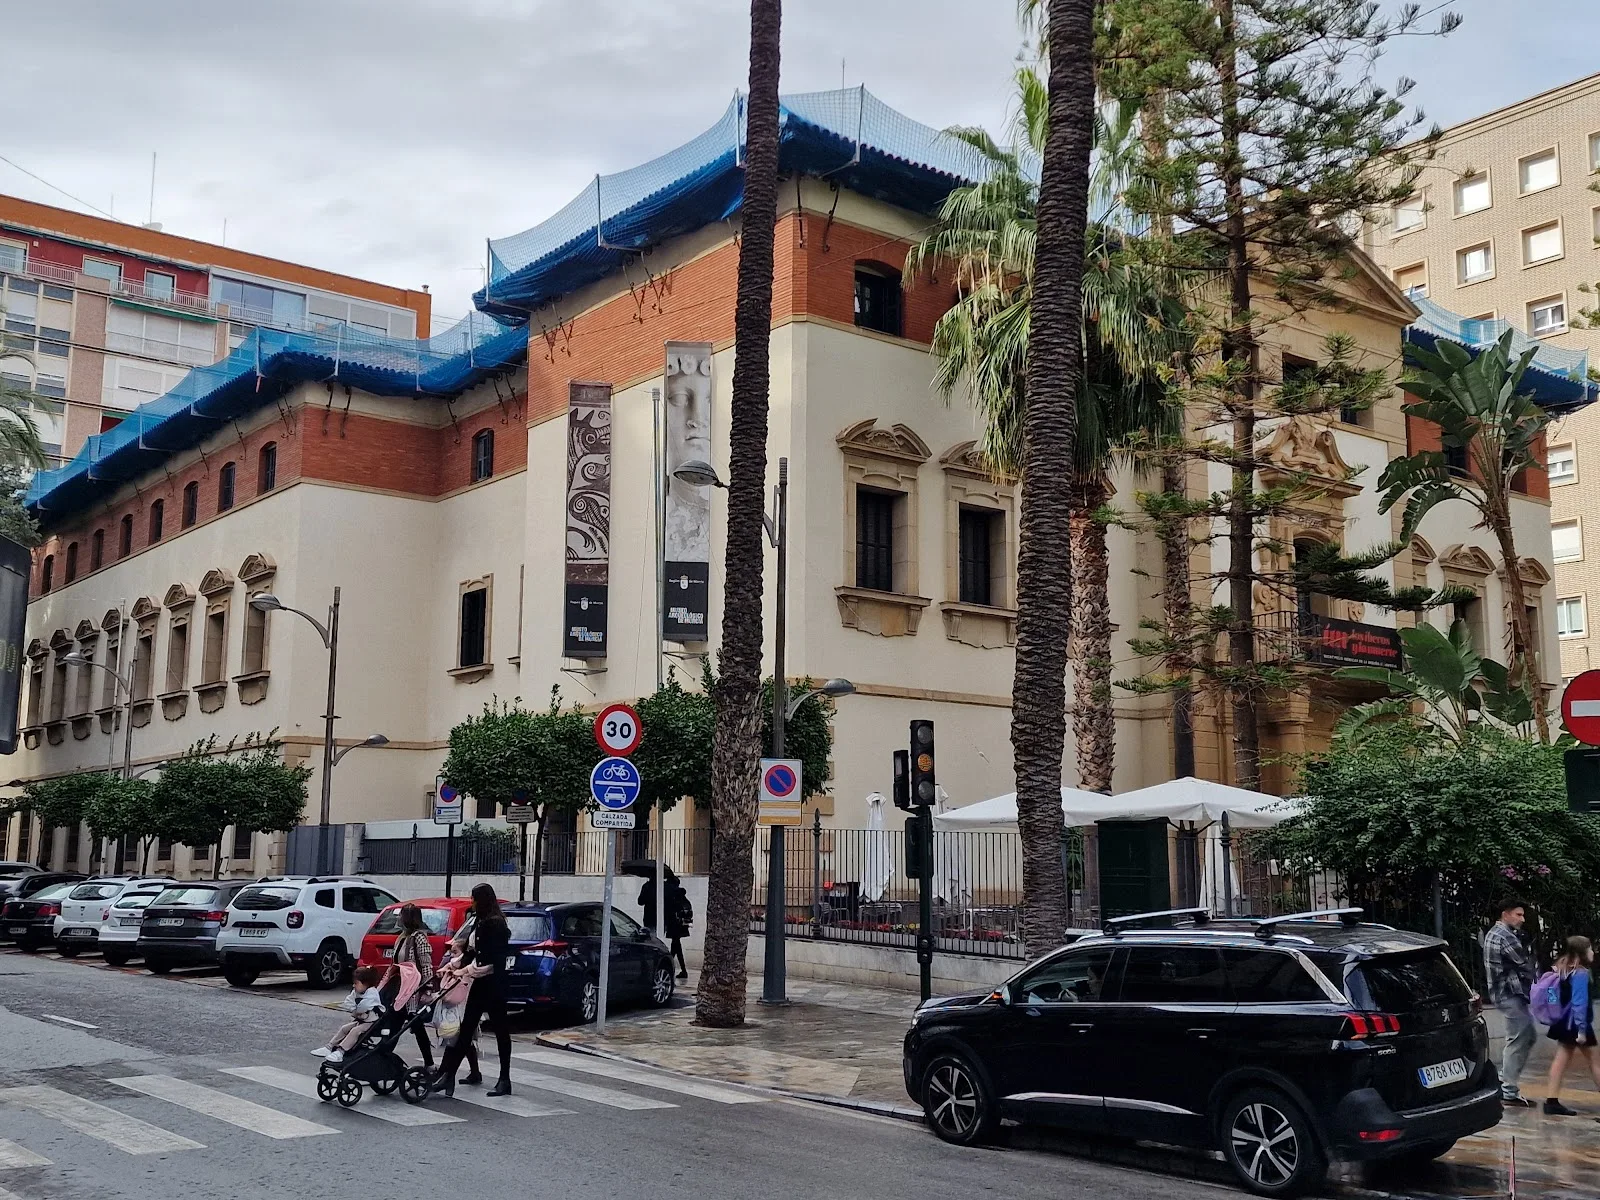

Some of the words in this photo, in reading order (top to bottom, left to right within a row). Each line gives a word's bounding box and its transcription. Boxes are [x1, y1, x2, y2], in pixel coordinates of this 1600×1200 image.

[606, 721, 631, 738] 30
[595, 819, 633, 827] COMPARTIDA
[1426, 1065, 1448, 1082] 8768
[1447, 1060, 1465, 1076] KCN
